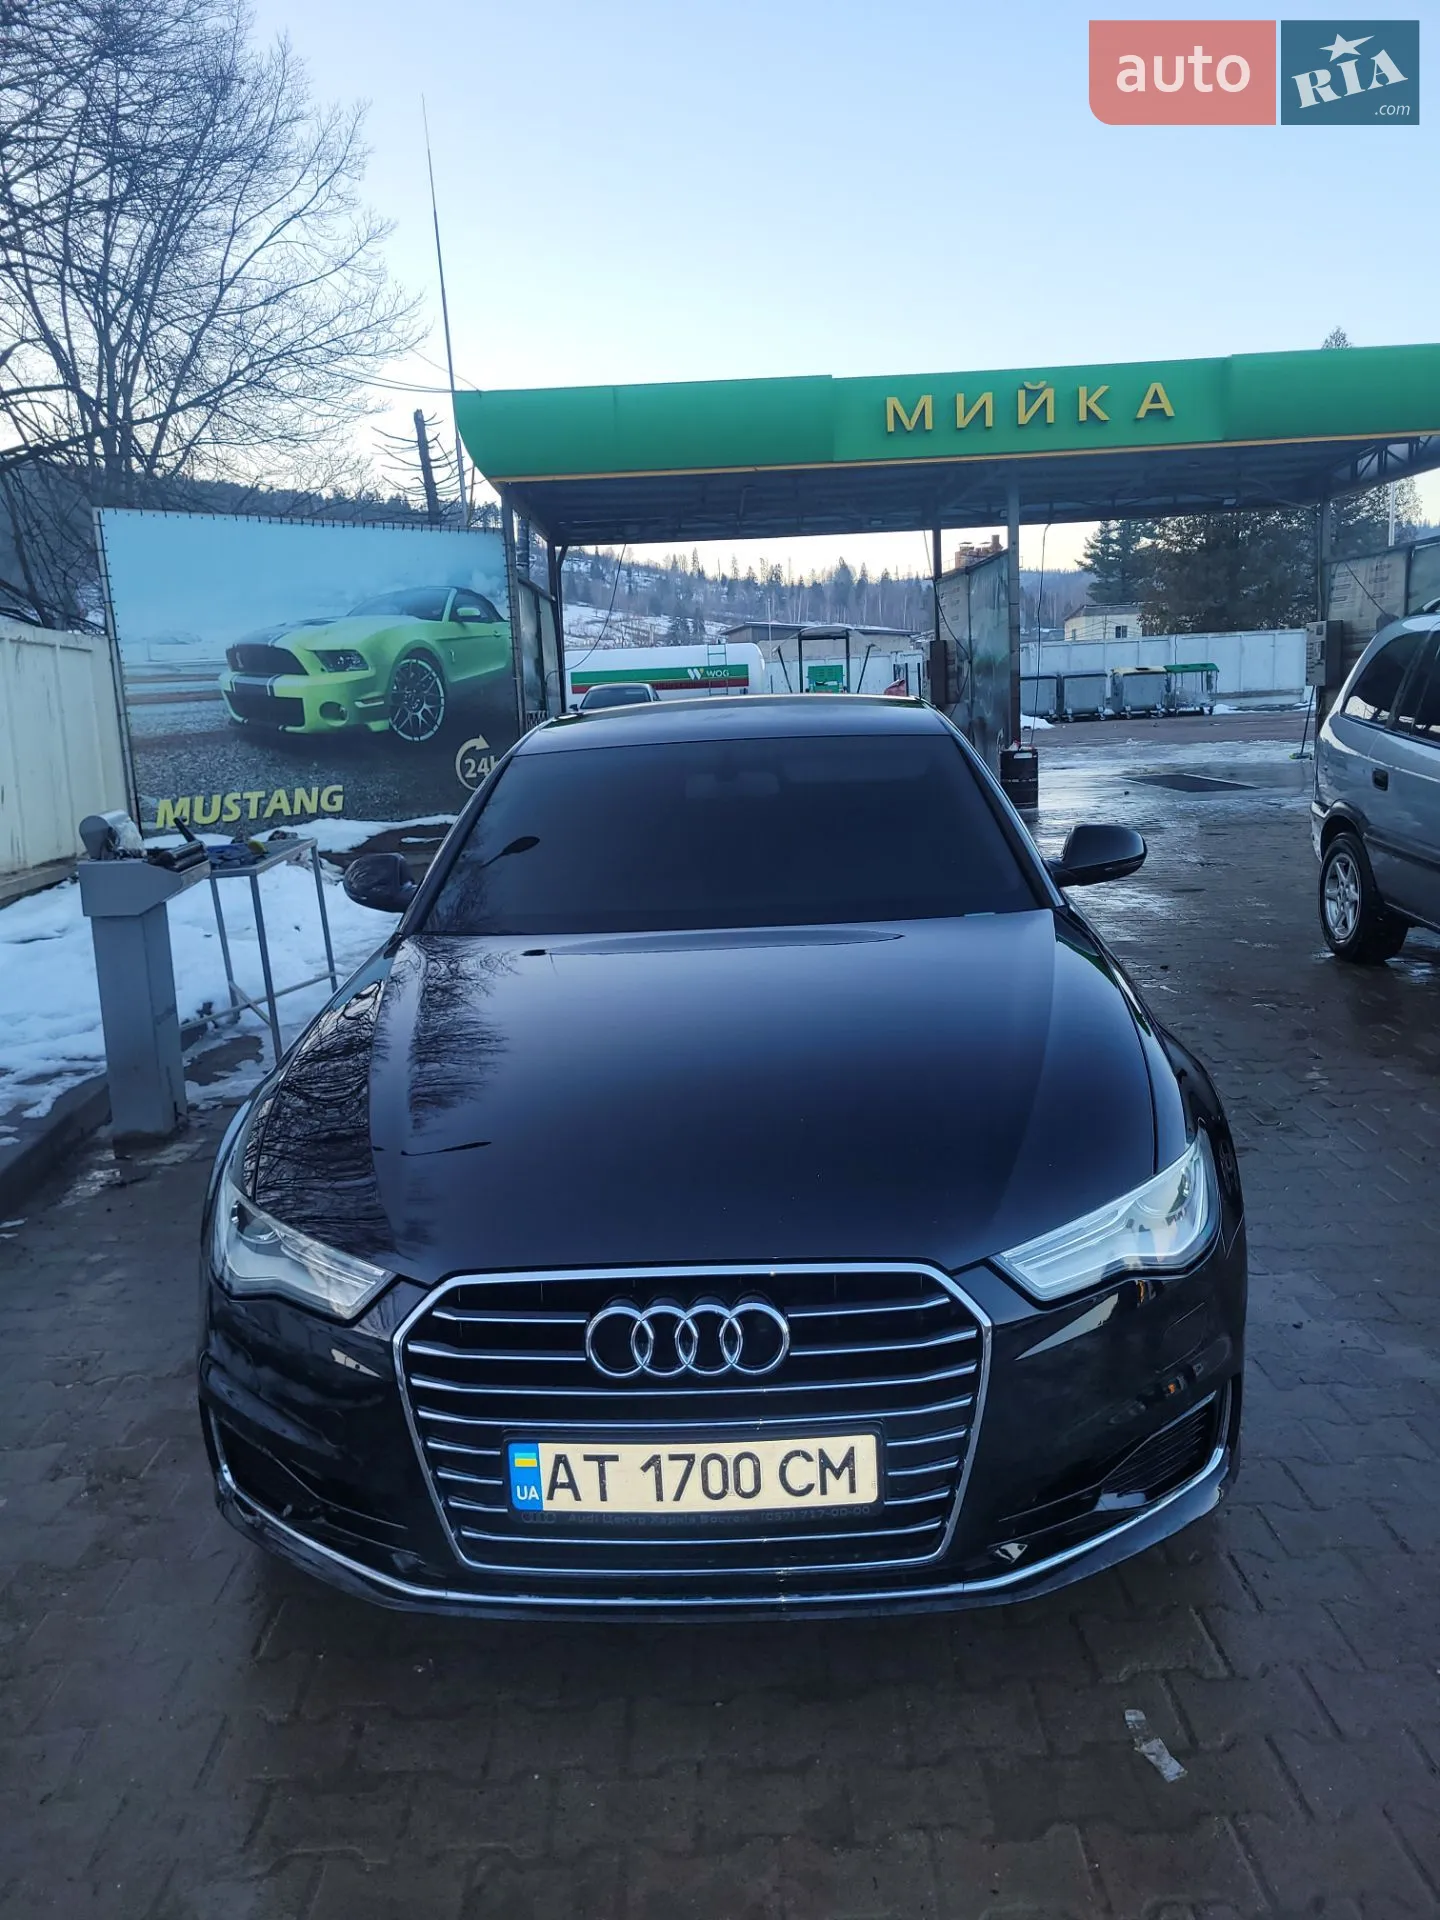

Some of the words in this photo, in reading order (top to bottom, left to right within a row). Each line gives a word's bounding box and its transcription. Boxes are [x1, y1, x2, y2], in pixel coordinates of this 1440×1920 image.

[886, 382, 1174, 432] МИЙКА
[706, 669, 729, 678] WOG
[156, 784, 344, 828] MUSTANG
[516, 1485, 541, 1500] UA
[546, 1454, 620, 1502] AT
[640, 1451, 762, 1502] 1700
[779, 1446, 857, 1498] CM
